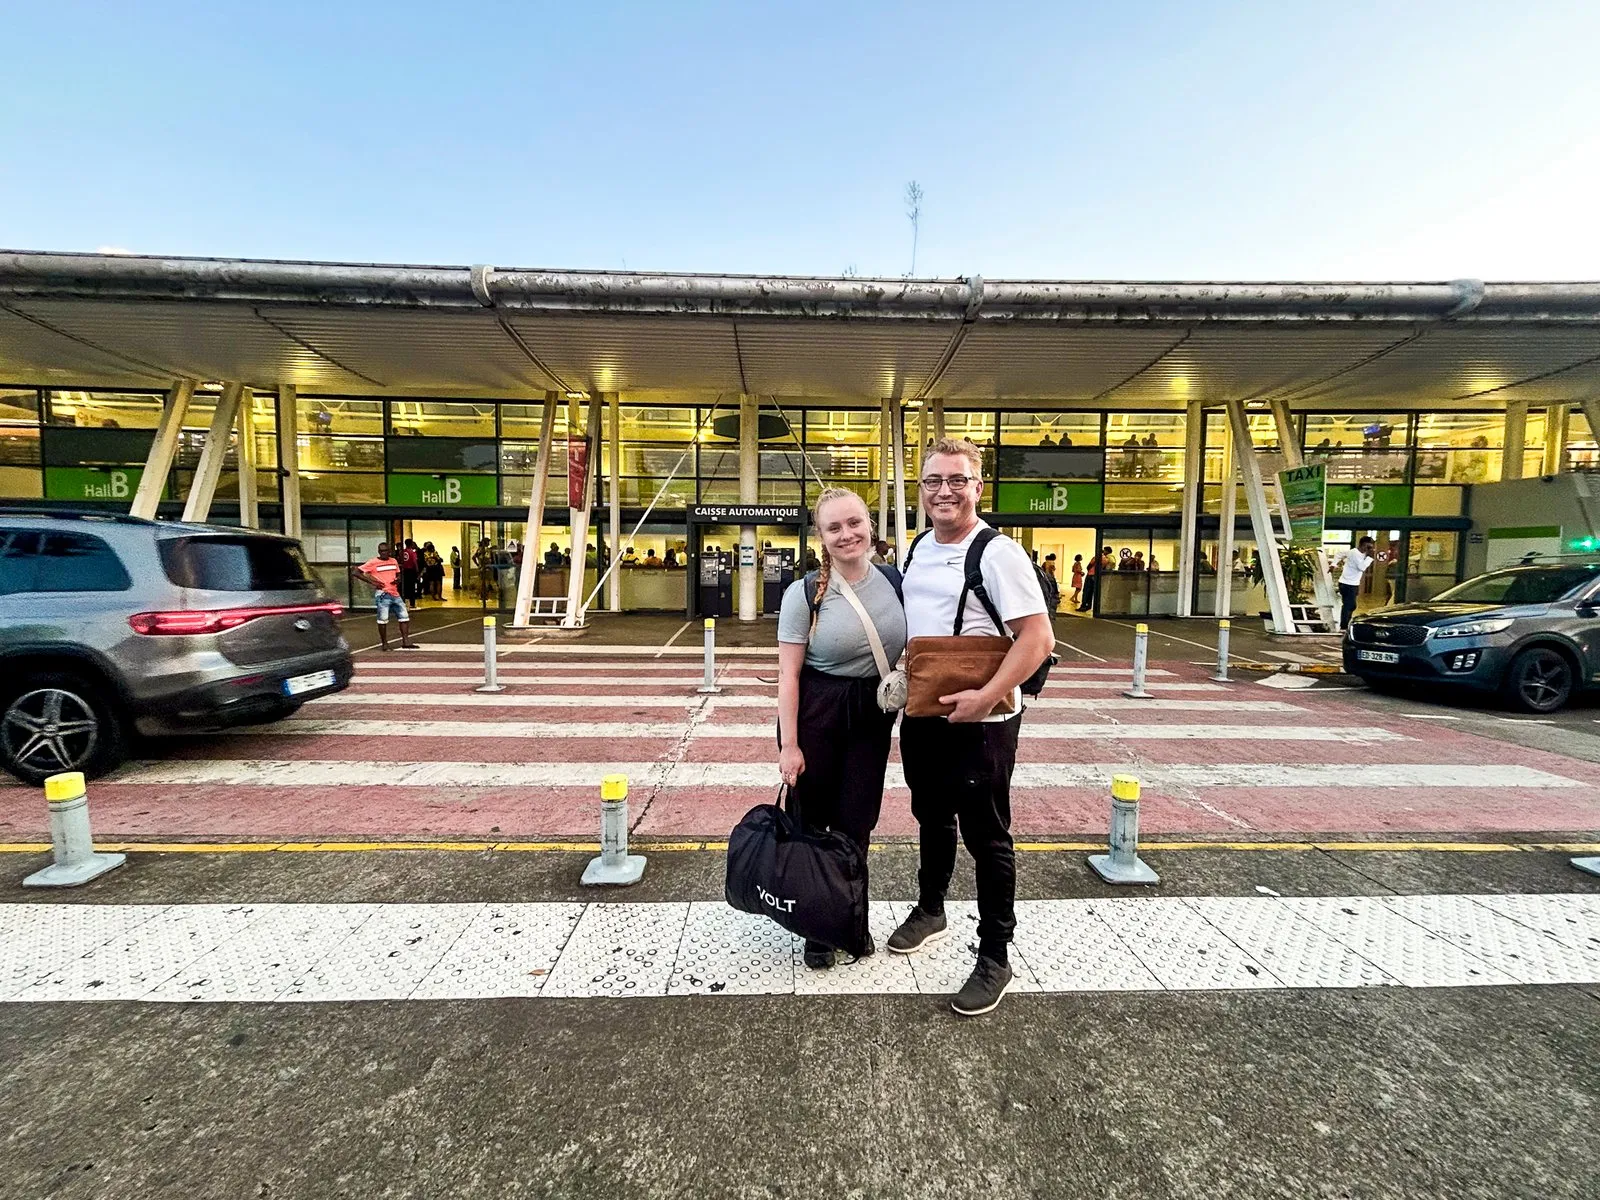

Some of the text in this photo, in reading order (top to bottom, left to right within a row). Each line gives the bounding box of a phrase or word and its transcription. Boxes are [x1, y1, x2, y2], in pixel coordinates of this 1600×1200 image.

[84, 471, 129, 498] Hall B
[1286, 465, 1320, 482] TAXI
[422, 478, 461, 504] Hall B
[1030, 486, 1068, 511] Hall B
[1334, 500, 1358, 514] Hall
[1358, 488, 1374, 514] B
[694, 507, 799, 517] CAISSE AUTOMATIQUE
[756, 885, 796, 912] VOLT
